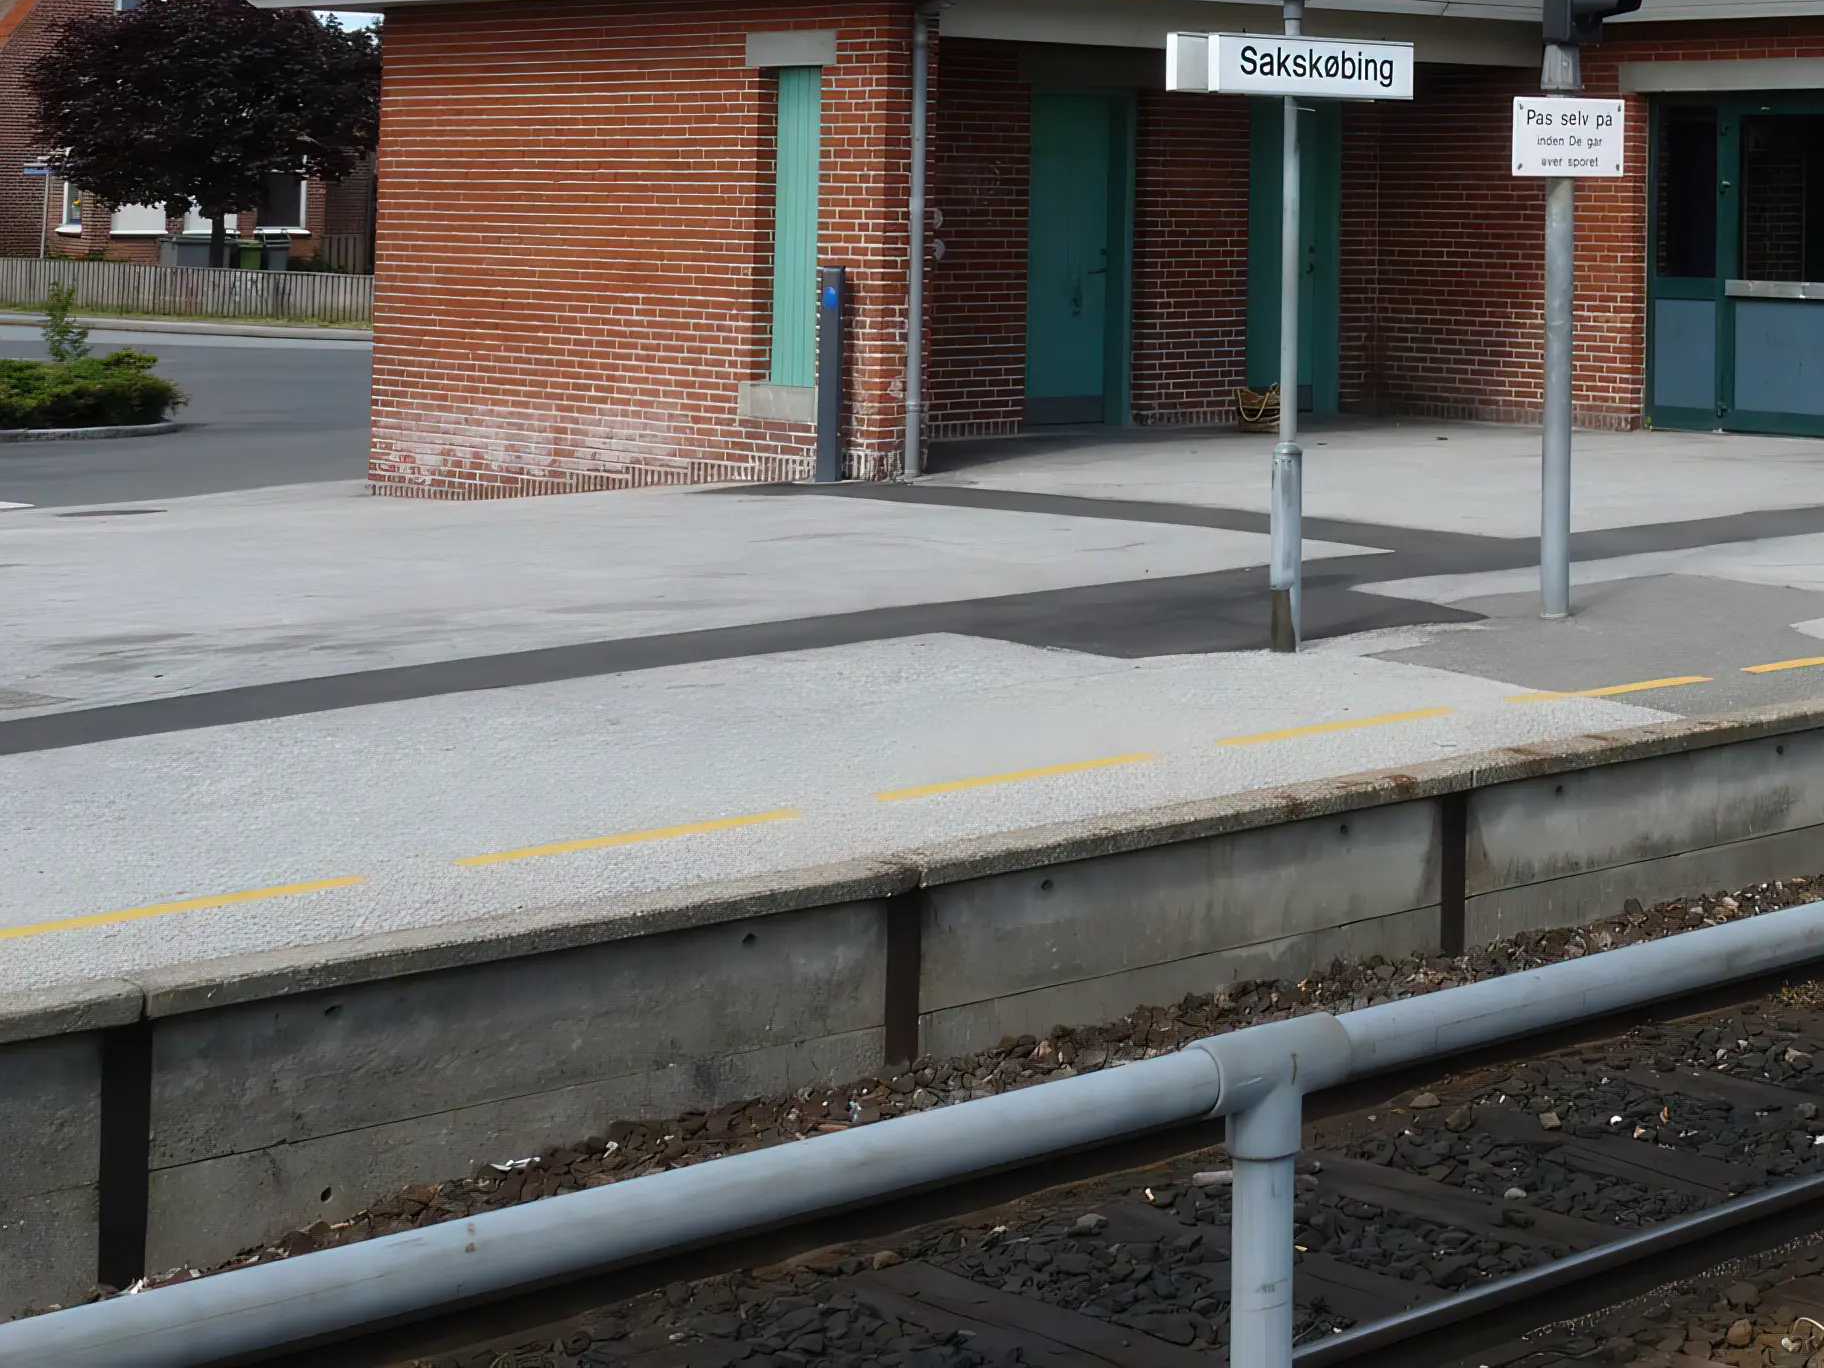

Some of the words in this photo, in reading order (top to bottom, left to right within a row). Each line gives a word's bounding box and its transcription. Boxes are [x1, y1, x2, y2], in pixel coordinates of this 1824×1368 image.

[1240, 45, 1394, 88] Sakskøbing
[1526, 109, 1553, 126] Pas
[1560, 110, 1589, 126] selv
[1537, 135, 1565, 146] inden
[1569, 135, 1582, 147] De
[1541, 157, 1563, 167] over
[1567, 157, 1599, 169] sporet
